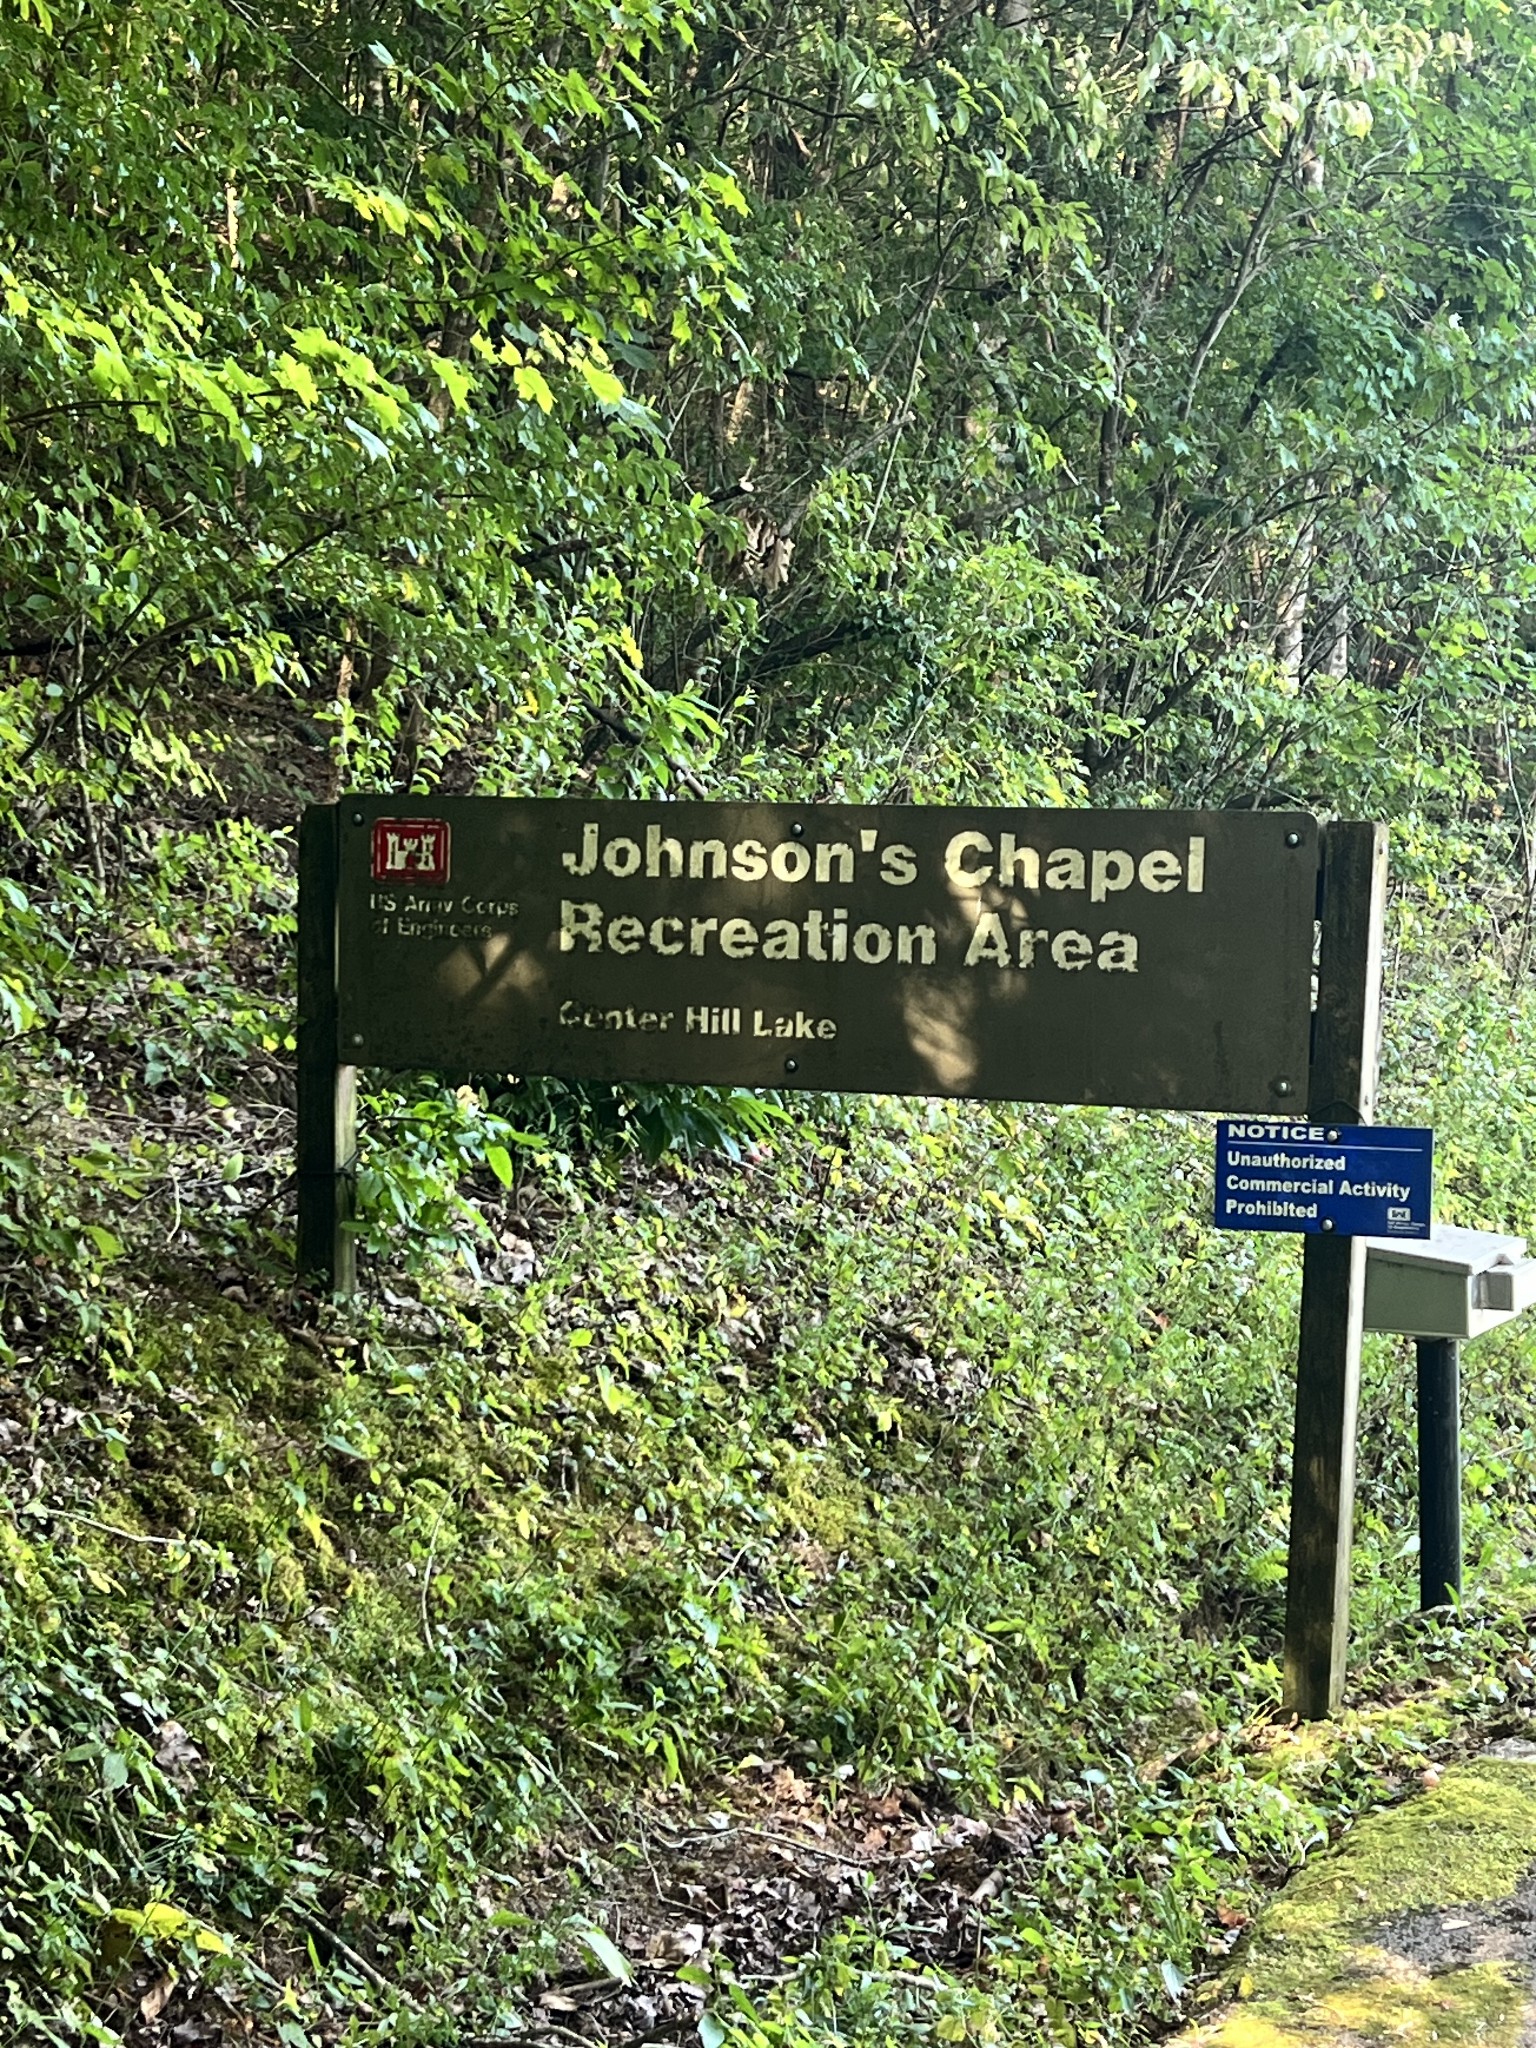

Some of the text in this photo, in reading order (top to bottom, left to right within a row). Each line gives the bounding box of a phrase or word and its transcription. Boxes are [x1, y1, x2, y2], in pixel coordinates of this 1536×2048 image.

[562, 823, 1205, 902] Johnson's Chapel
[560, 900, 1139, 972] Recreation Area
[686, 1006, 741, 1034] Hill
[753, 1009, 837, 1039] Lake
[1228, 1124, 1325, 1141] NOTICE
[1227, 1151, 1346, 1171] Unauthorized
[1226, 1175, 1411, 1202] Commercial Activity
[1226, 1199, 1317, 1218] Prohibited
